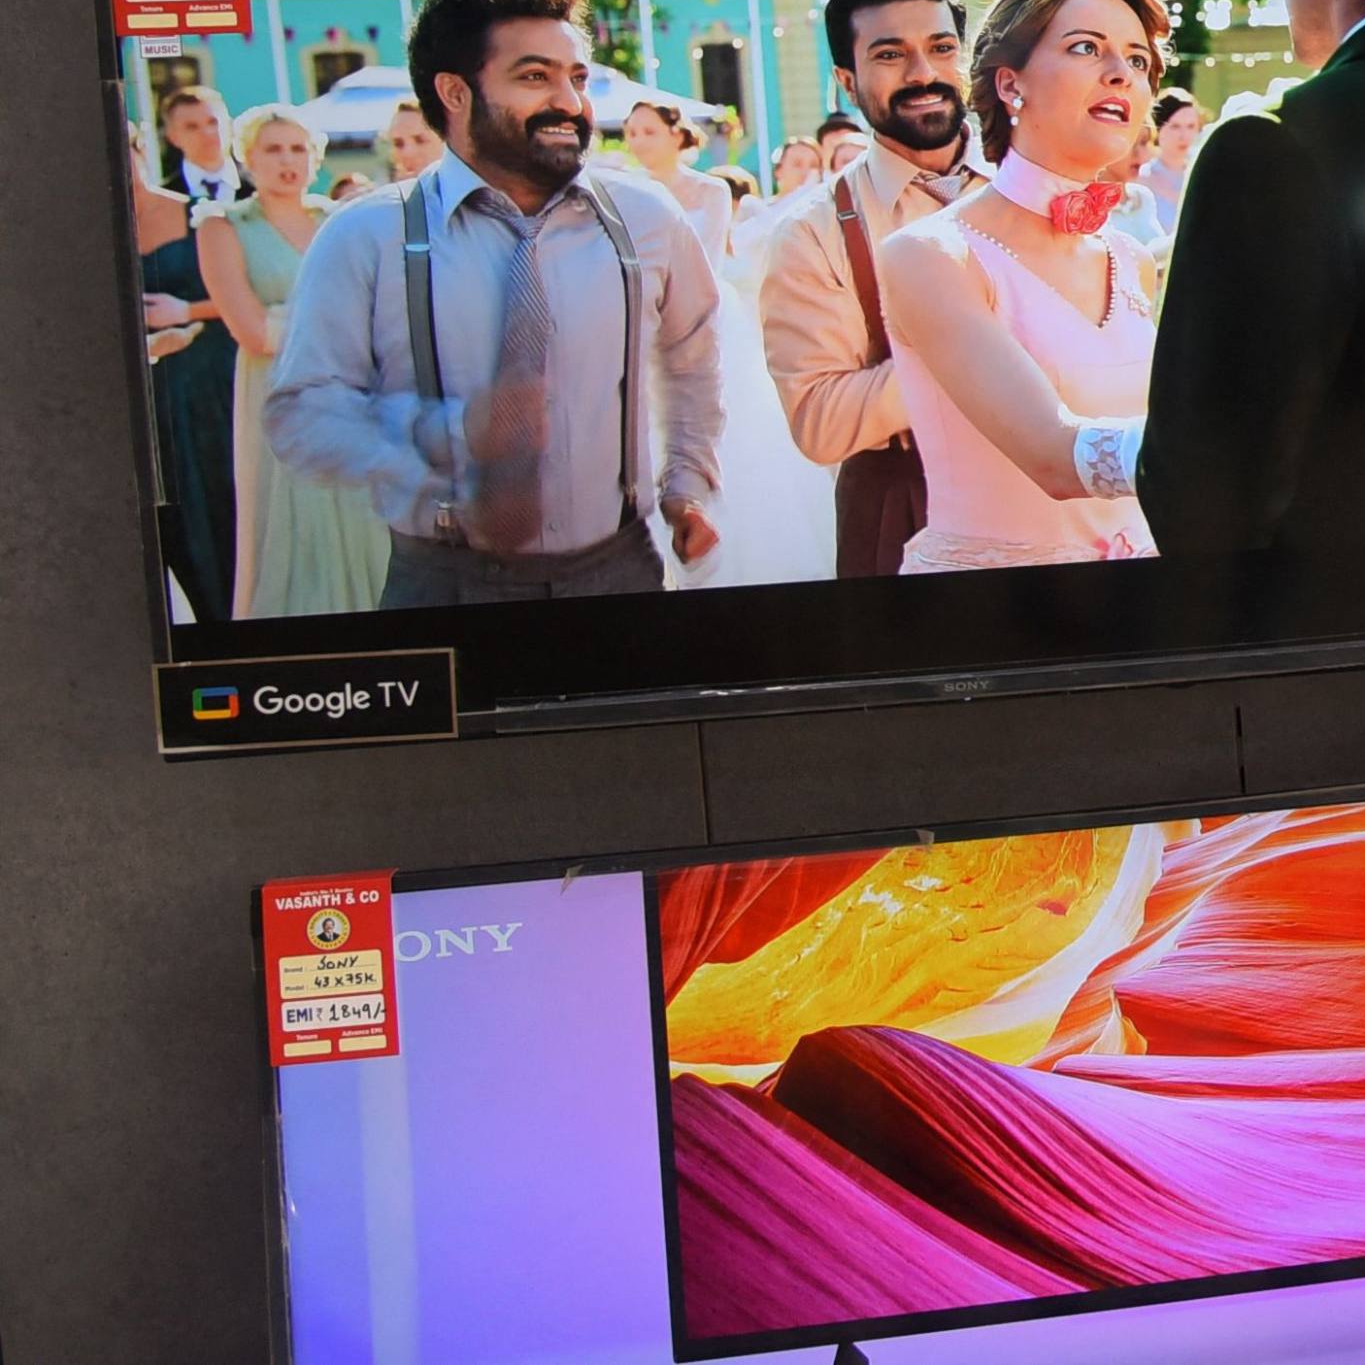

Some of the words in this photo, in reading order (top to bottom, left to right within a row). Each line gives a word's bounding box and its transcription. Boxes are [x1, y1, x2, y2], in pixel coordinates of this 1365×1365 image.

[144, 45, 179, 54] MUSIC
[944, 680, 989, 692] SONY
[253, 683, 371, 719] Google
[377, 681, 420, 707] TV
[275, 894, 341, 910] VASANTH
[346, 892, 355, 905] &
[359, 890, 380, 903] CO
[395, 923, 523, 963] ONY
[317, 956, 359, 970] SONY
[286, 1007, 313, 1024] EMI
